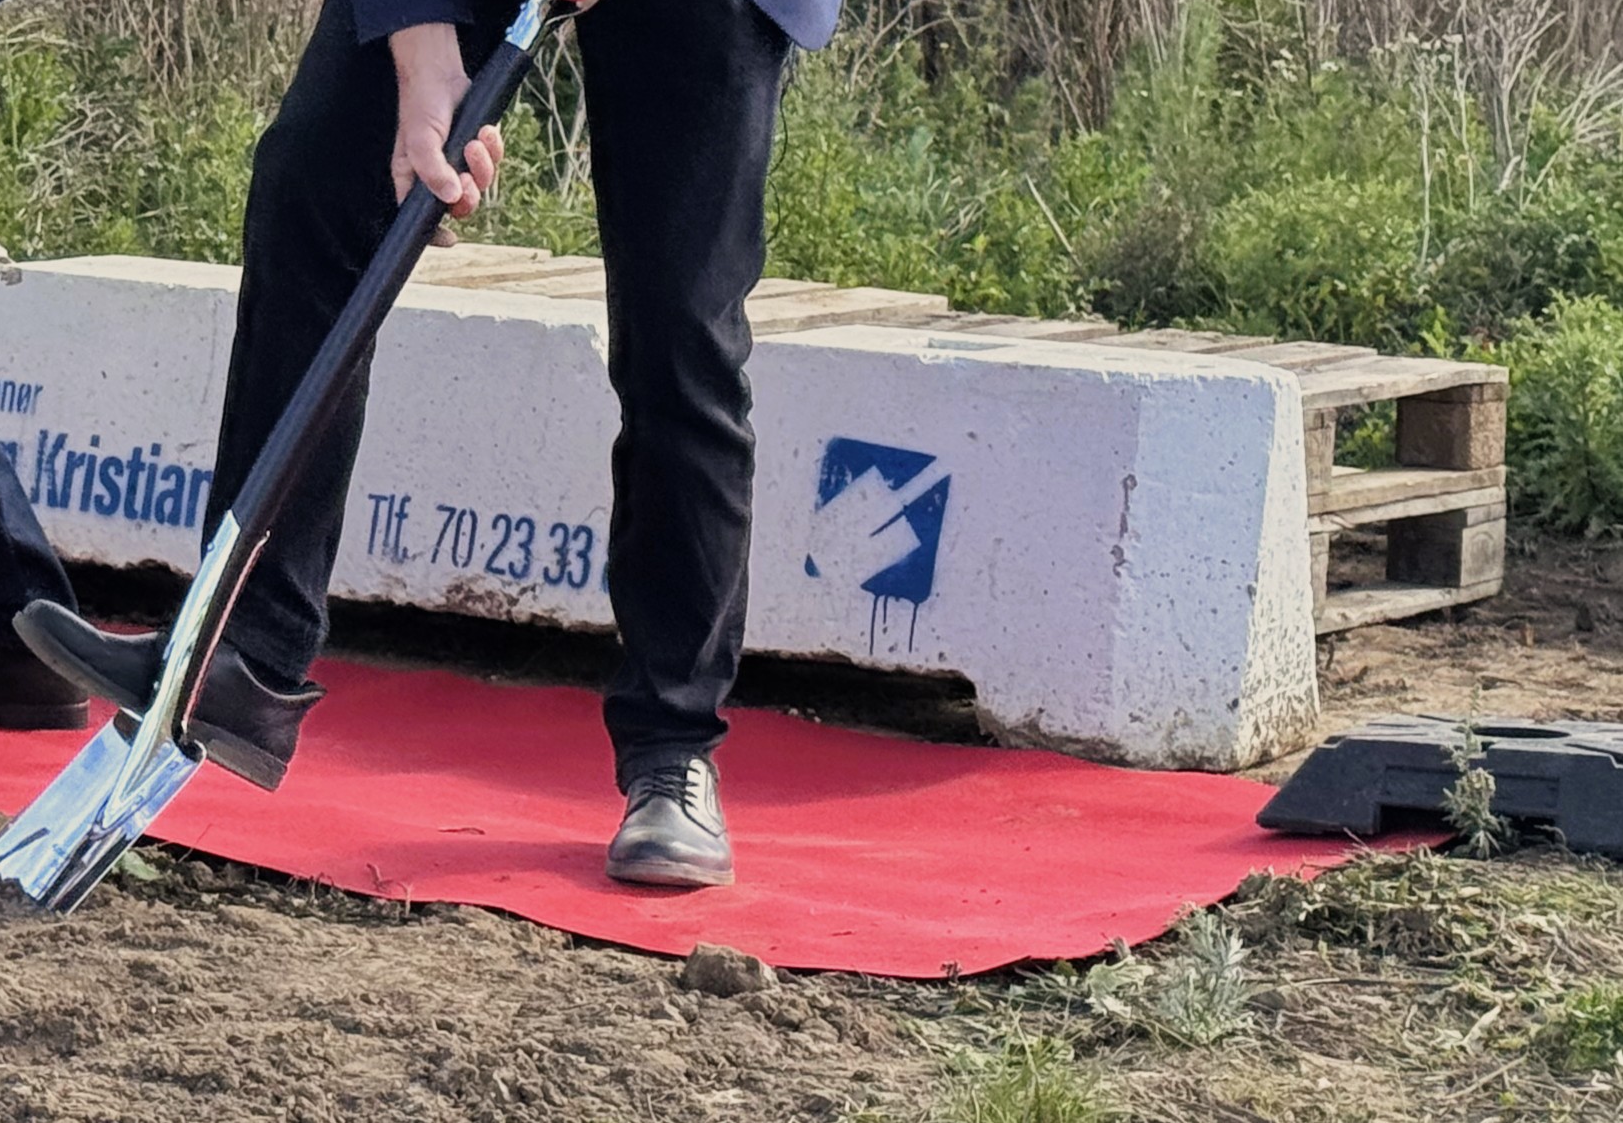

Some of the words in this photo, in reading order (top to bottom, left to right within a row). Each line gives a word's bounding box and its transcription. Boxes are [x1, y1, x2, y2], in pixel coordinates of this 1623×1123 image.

[430, 504, 479, 568] 70
[484, 513, 537, 580] 23
[542, 522, 594, 589] 33
